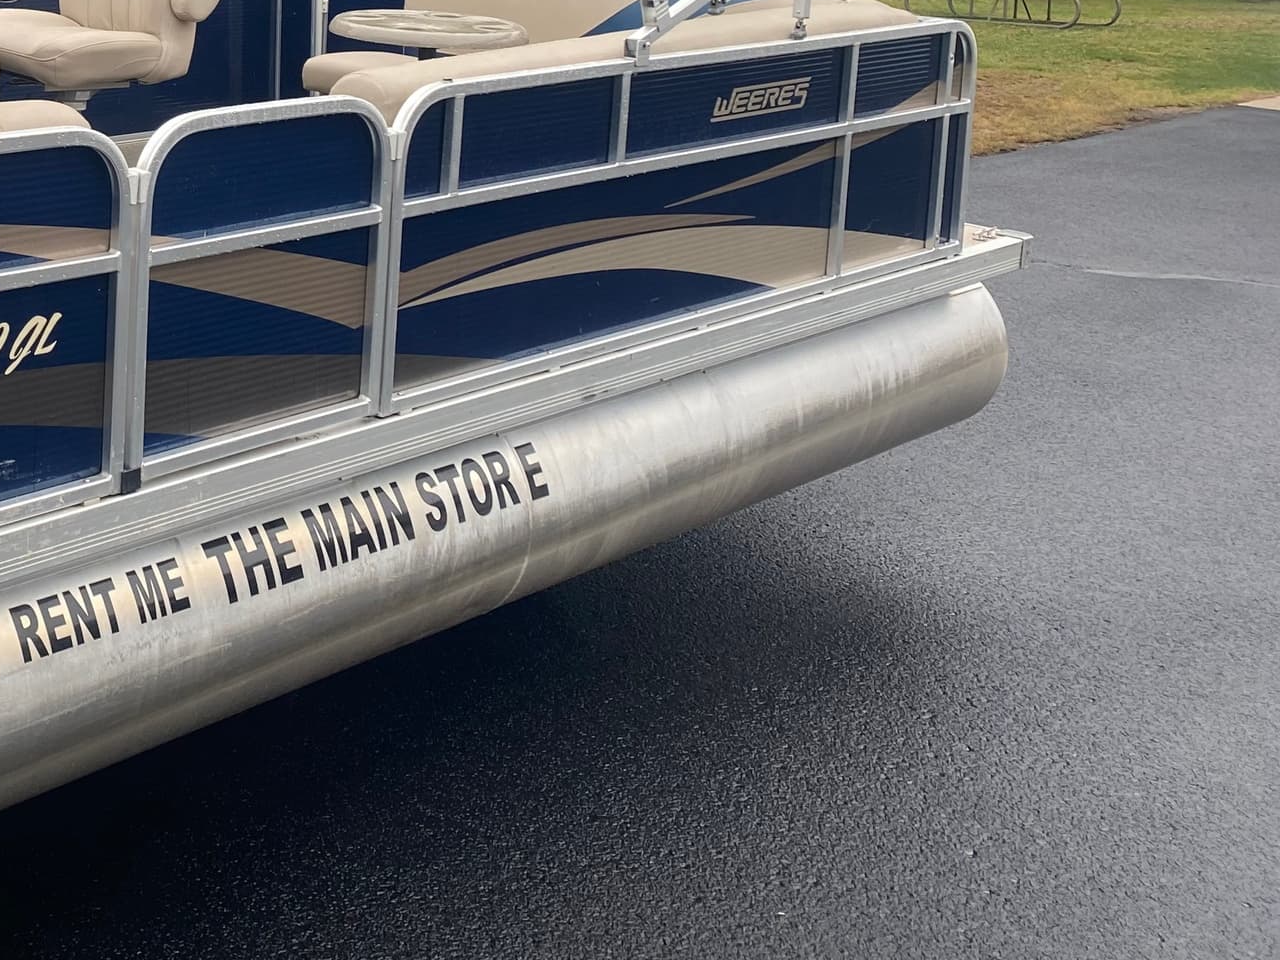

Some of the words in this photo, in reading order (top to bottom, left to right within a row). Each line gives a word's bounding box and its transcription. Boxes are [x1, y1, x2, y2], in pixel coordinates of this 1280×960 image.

[710, 76, 813, 123] WEERES
[8, 577, 120, 664] RENT
[126, 556, 192, 624] ME
[201, 517, 304, 604] THE
[300, 481, 416, 572] MAIN
